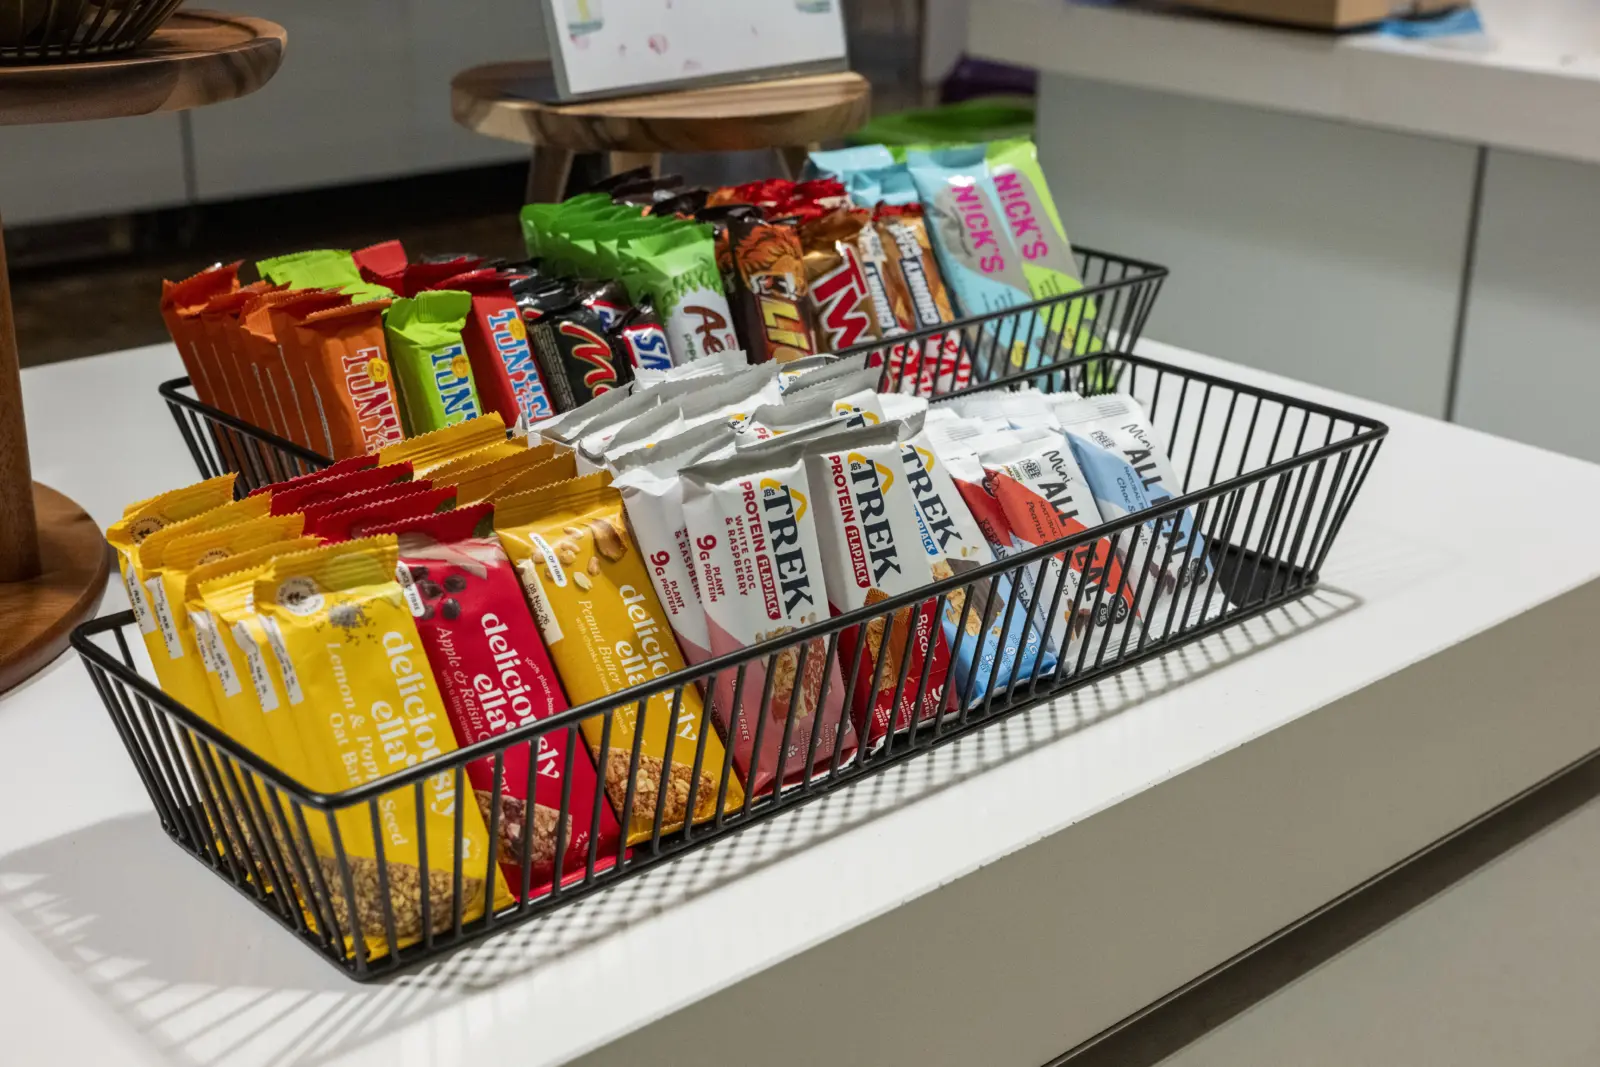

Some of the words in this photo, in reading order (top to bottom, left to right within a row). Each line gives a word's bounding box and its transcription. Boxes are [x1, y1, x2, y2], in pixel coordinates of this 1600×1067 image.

[1121, 424, 1155, 452] Mini
[1042, 450, 1073, 484] Mini
[1124, 449, 1162, 492] ALL
[901, 445, 962, 549] TREK
[1117, 477, 1130, 505] Choc
[828, 455, 856, 523] PROTEIN
[847, 530, 868, 584] FLAPJACK
[850, 460, 901, 583] TREK
[1026, 501, 1045, 540] Peanut
[697, 535, 717, 560] 9G
[735, 516, 749, 554] WHITE
[744, 558, 756, 589] CHOC
[739, 481, 766, 552] PROTEIN
[757, 558, 780, 616] FLAPJACK
[763, 485, 813, 615] TREK
[1038, 480, 1080, 527] ALL
[1078, 544, 1110, 602] EAL
[650, 551, 670, 576] 9G
[704, 563, 717, 602] PROTEIN
[713, 567, 725, 596] PLANT
[728, 530, 748, 596] RASPBERRY
[528, 583, 537, 596] 08
[532, 594, 544, 612] Nov
[661, 578, 678, 615] PROTEIN
[669, 581, 685, 608] PLANT
[541, 611, 550, 625] 26
[578, 600, 604, 644] Peanut
[598, 646, 622, 684] Butter
[436, 626, 460, 667] Apple
[460, 688, 483, 731] Raisin
[525, 657, 540, 675] 100%
[619, 584, 696, 742] delicioly
[473, 674, 508, 732] ella
[326, 642, 357, 710] Lemon
[349, 714, 365, 730] &
[380, 799, 408, 846] Seed
[329, 712, 348, 746] Oat
[370, 700, 408, 764] ella
[738, 719, 749, 741] FREE
